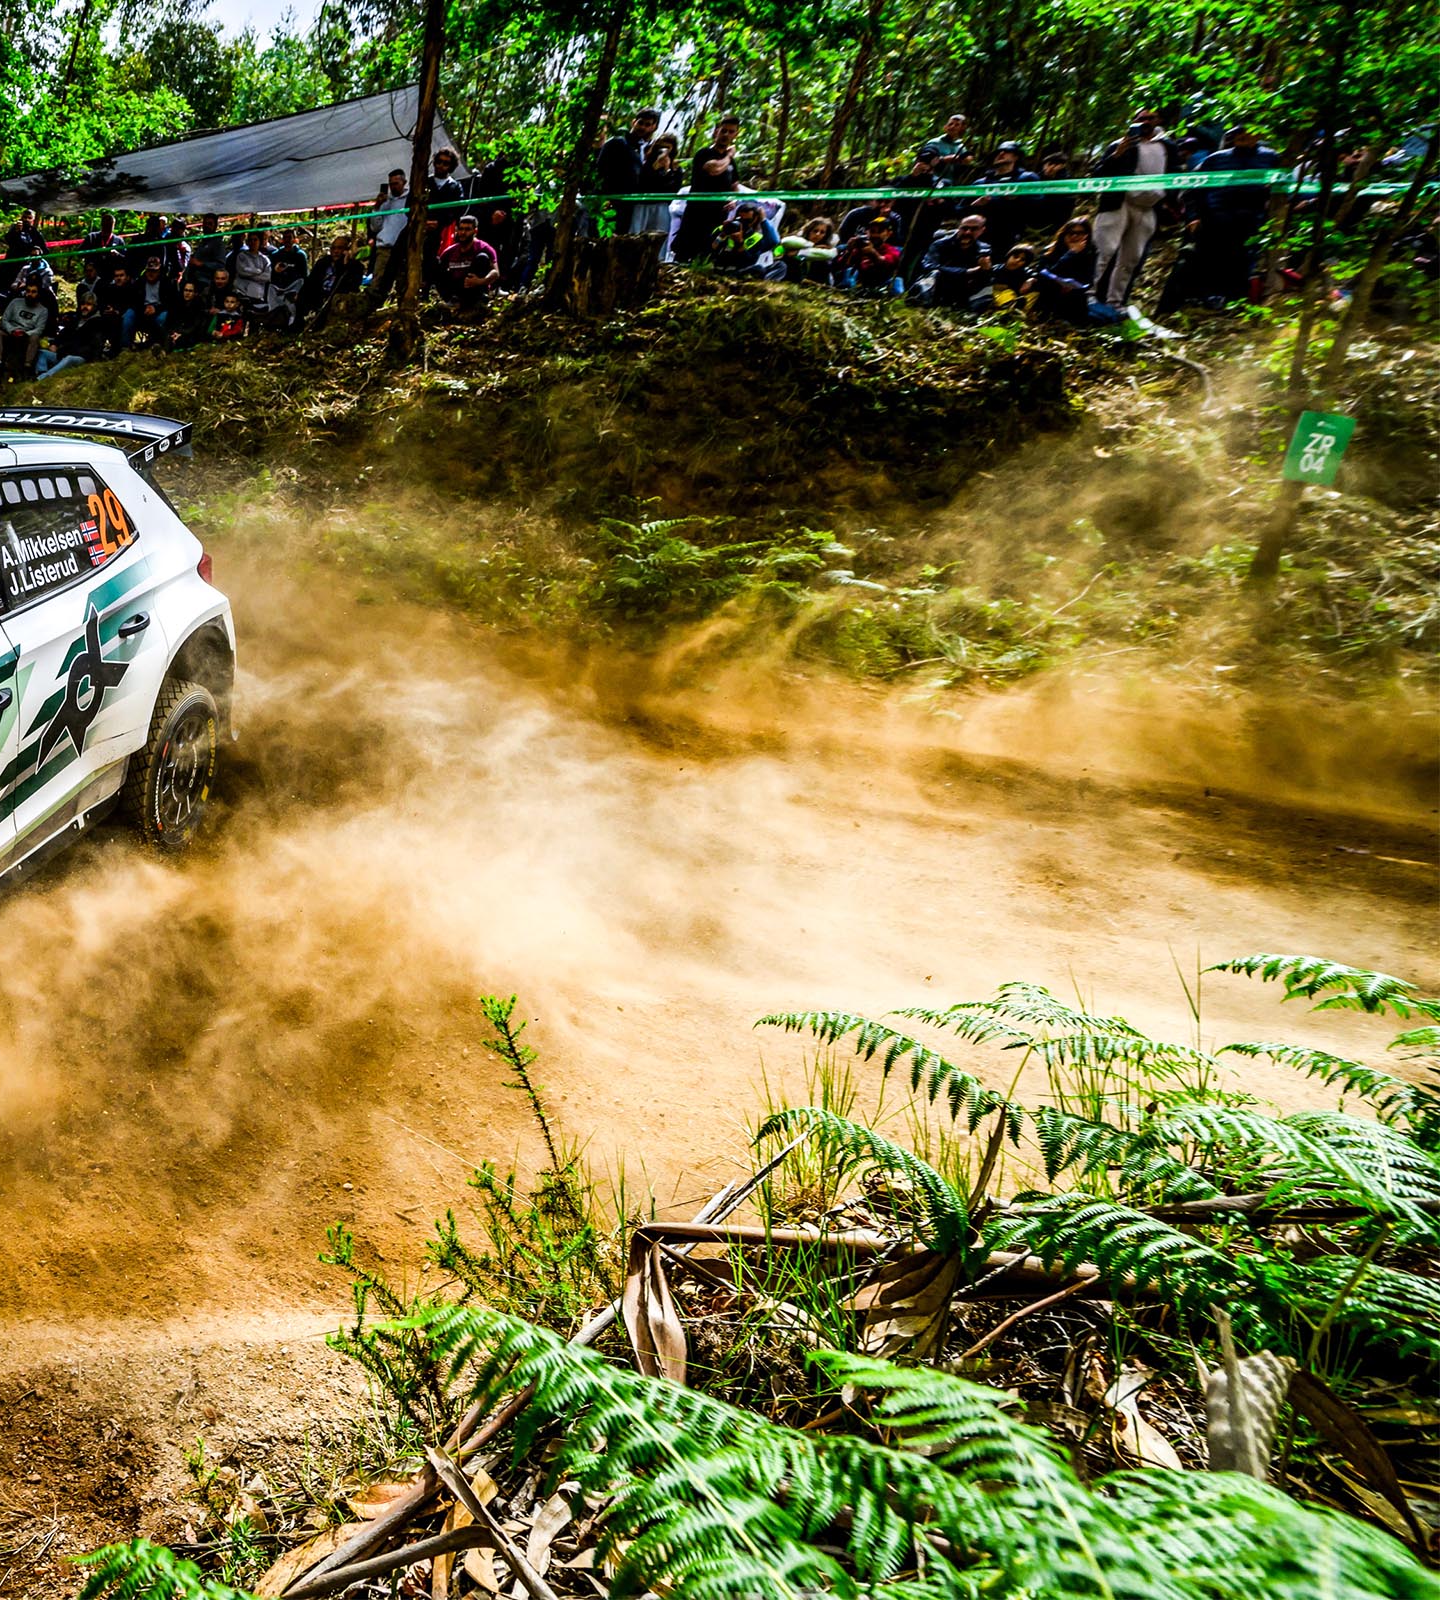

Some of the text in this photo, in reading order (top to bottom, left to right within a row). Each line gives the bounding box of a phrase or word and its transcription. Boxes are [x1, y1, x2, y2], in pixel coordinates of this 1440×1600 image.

[1299, 453, 1327, 474] 04
[1302, 432, 1336, 455] ZR
[87, 487, 134, 556] 29
[0, 528, 84, 569] A.Mikkelsen
[9, 552, 80, 596] J.Listerud
